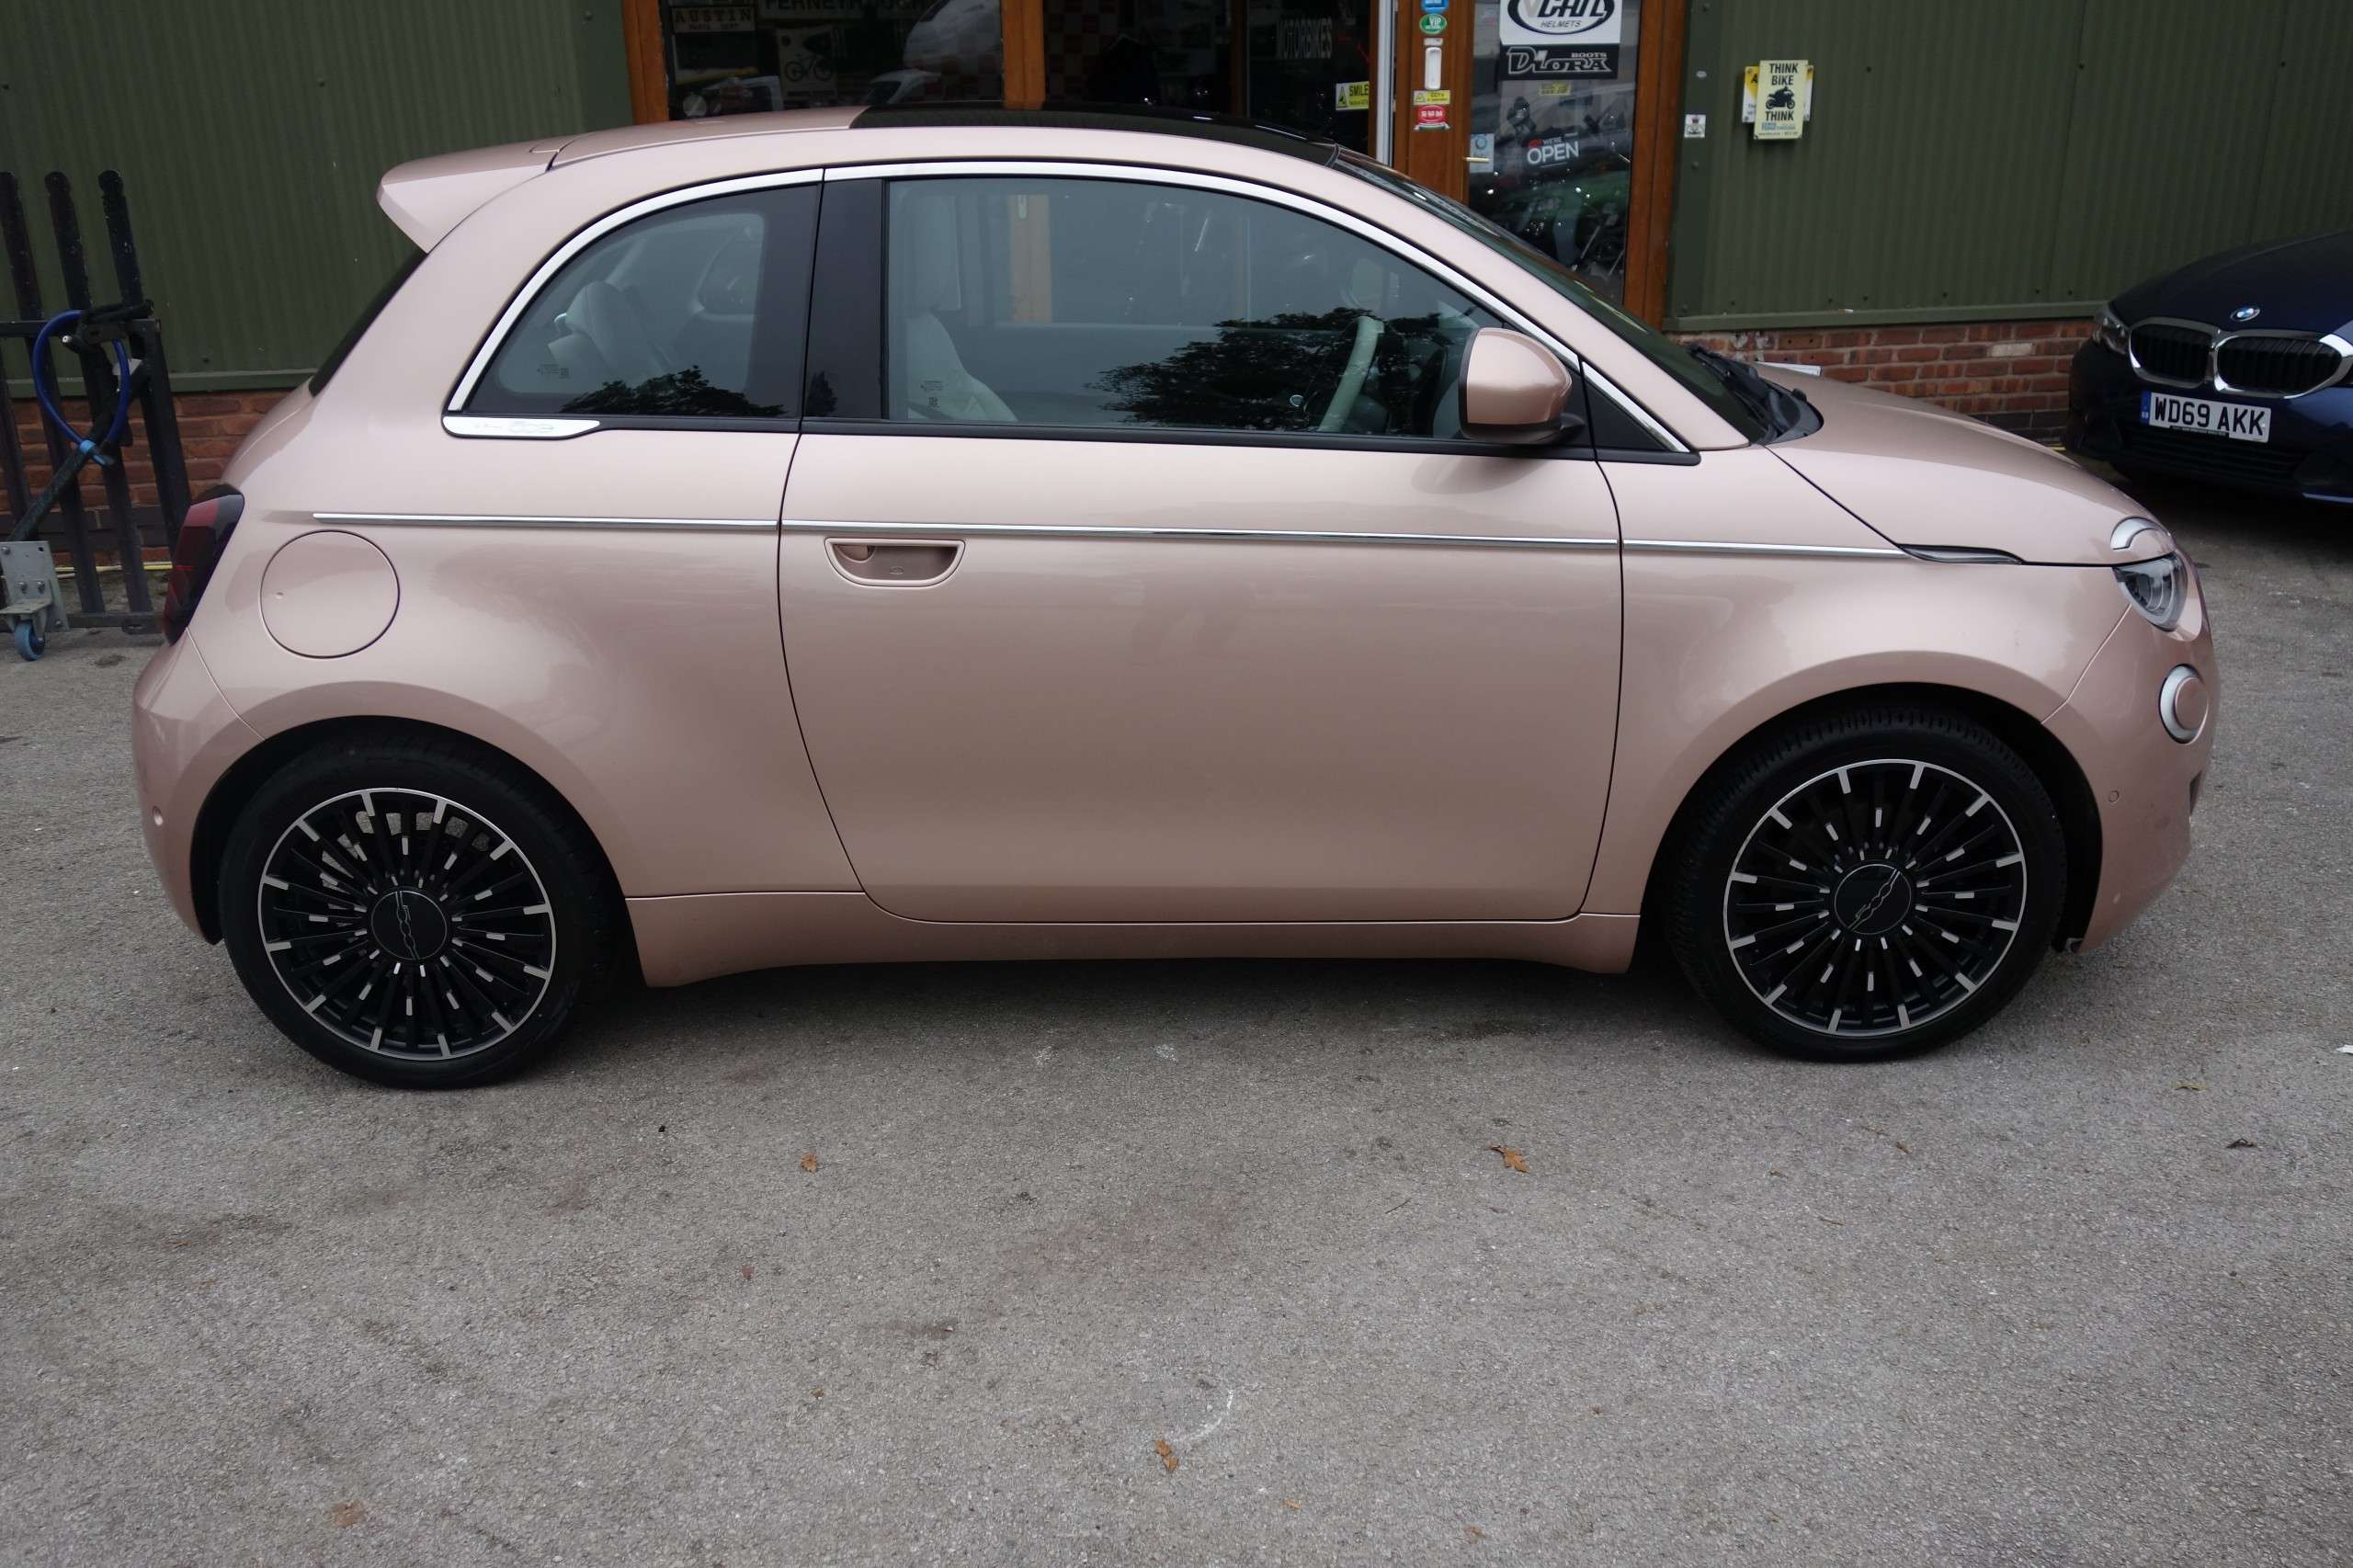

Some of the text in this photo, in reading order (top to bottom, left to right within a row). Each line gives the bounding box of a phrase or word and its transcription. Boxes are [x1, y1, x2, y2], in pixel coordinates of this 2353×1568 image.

[676, 8, 751, 23] AUSTIN
[1540, 19, 1581, 28] HELMETS
[1277, 17, 1333, 59] MOTORBIKES
[1769, 63, 1799, 74] THINK
[1771, 74, 1794, 85] BIKE
[1349, 84, 1369, 96] SMILE
[1765, 110, 1794, 121] THINK
[1527, 141, 1579, 165] OPEN
[2154, 396, 2265, 436] WD69 AKK
